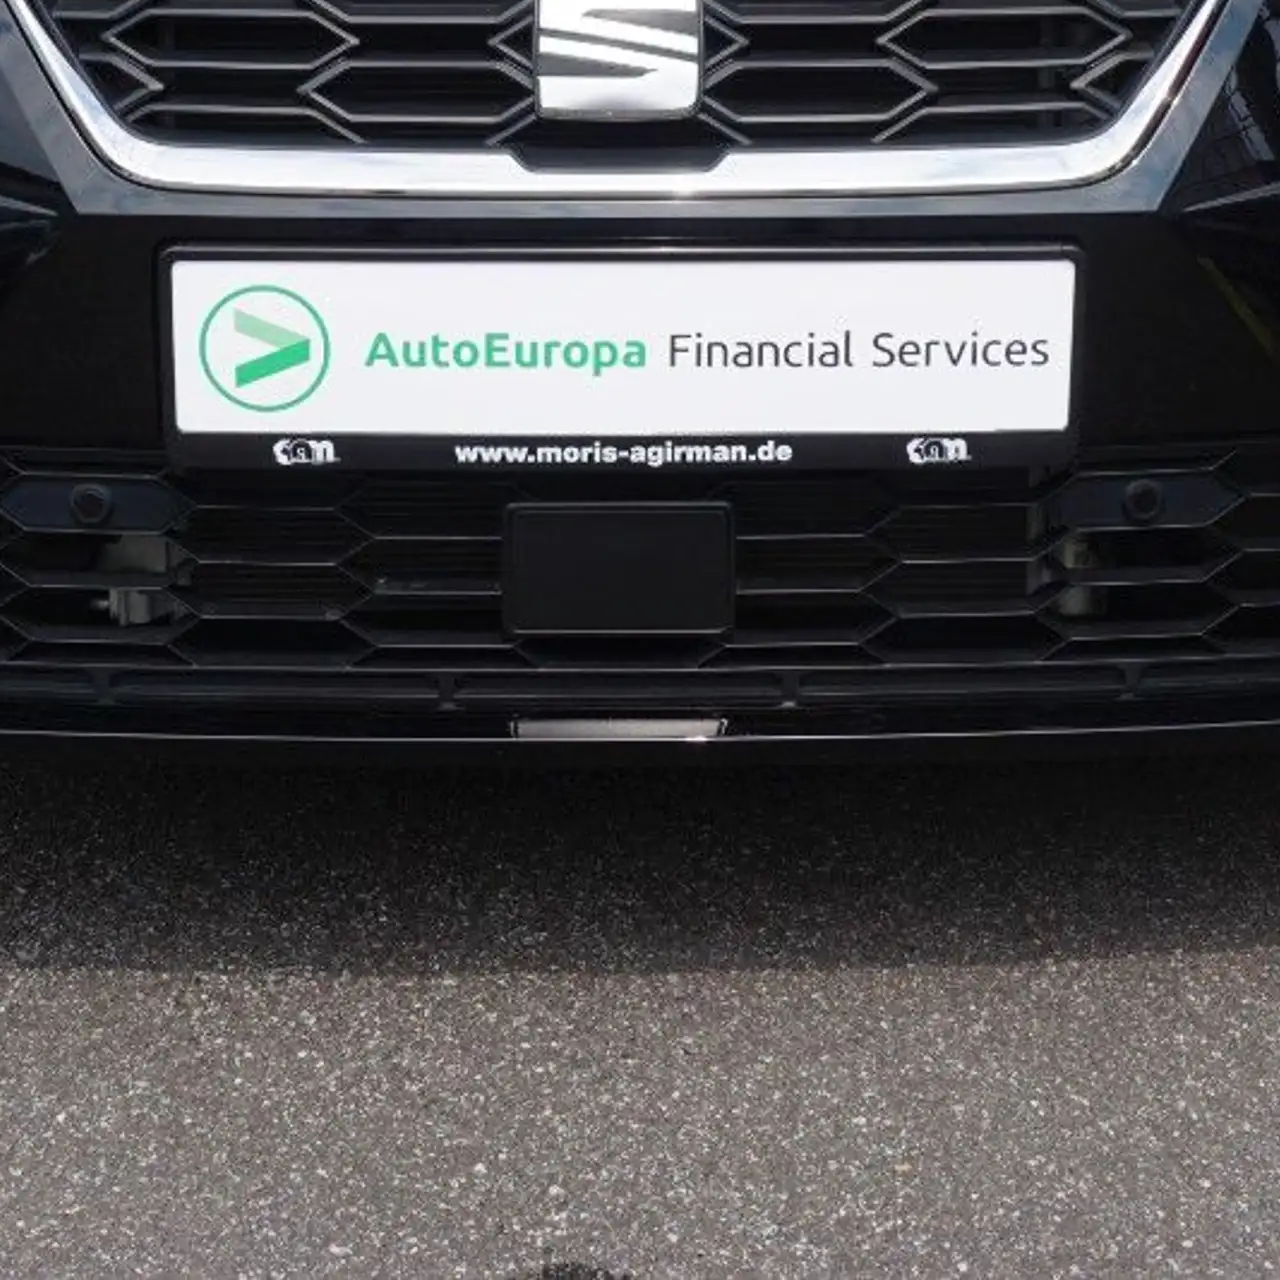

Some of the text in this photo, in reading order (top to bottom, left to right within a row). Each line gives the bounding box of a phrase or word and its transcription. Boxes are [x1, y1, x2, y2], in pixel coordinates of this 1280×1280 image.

[364, 329, 1050, 378] AutoEuropa Financial Services
[454, 439, 794, 468] www.moris-agirman.de
